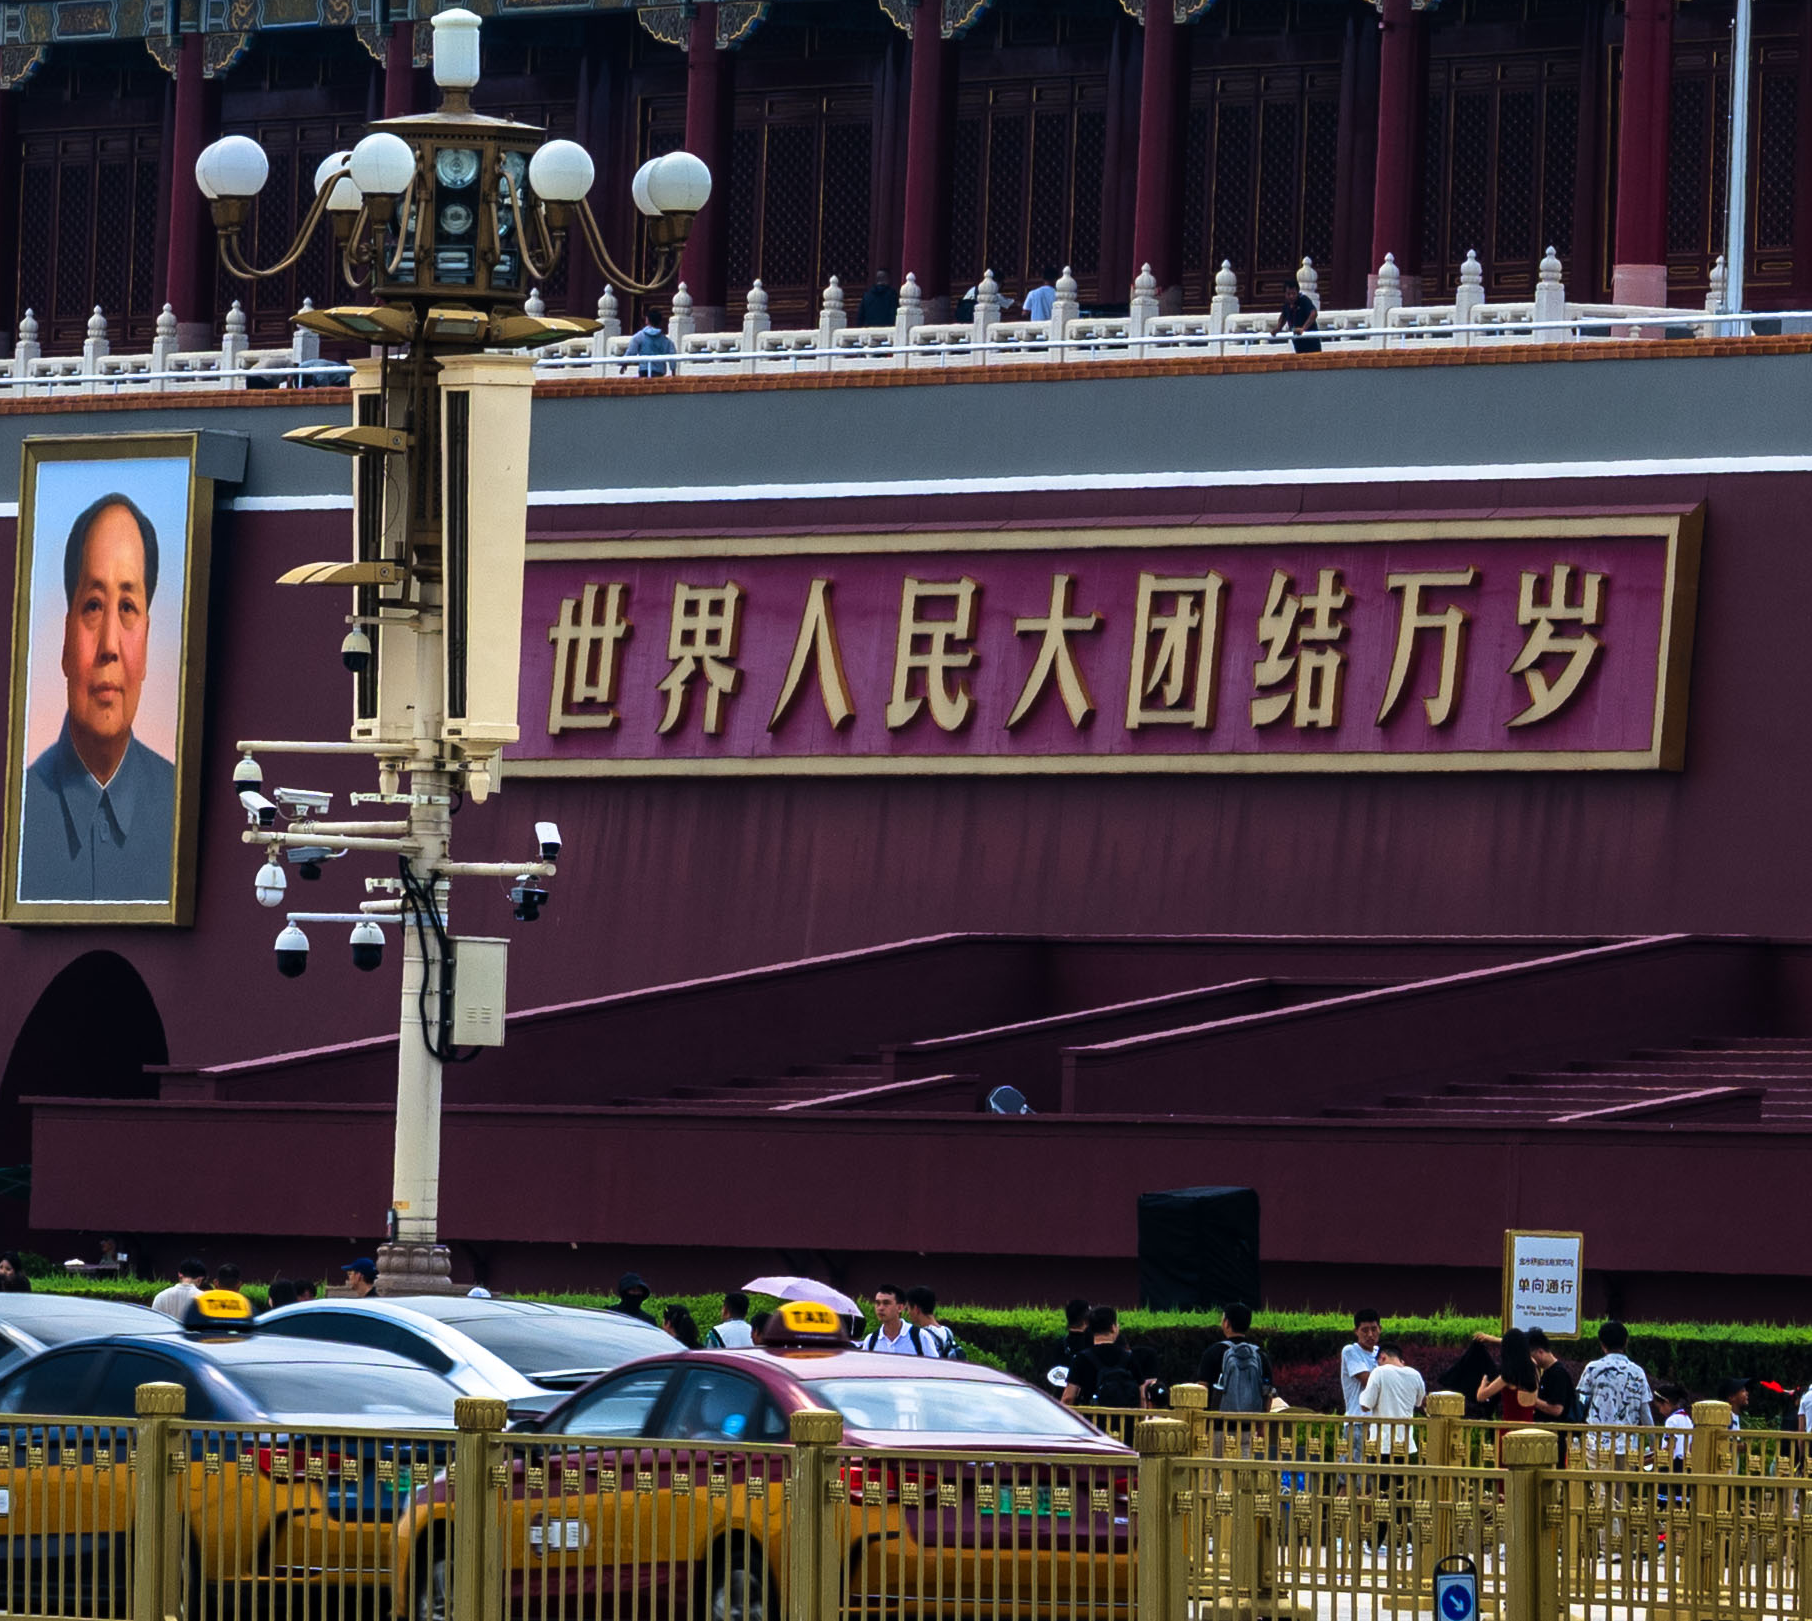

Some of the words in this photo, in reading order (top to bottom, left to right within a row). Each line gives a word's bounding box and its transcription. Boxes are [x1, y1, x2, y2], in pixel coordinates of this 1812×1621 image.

[545, 561, 1610, 736] 世界人民大团结万岁
[1519, 1278, 1574, 1294] 单向通行
